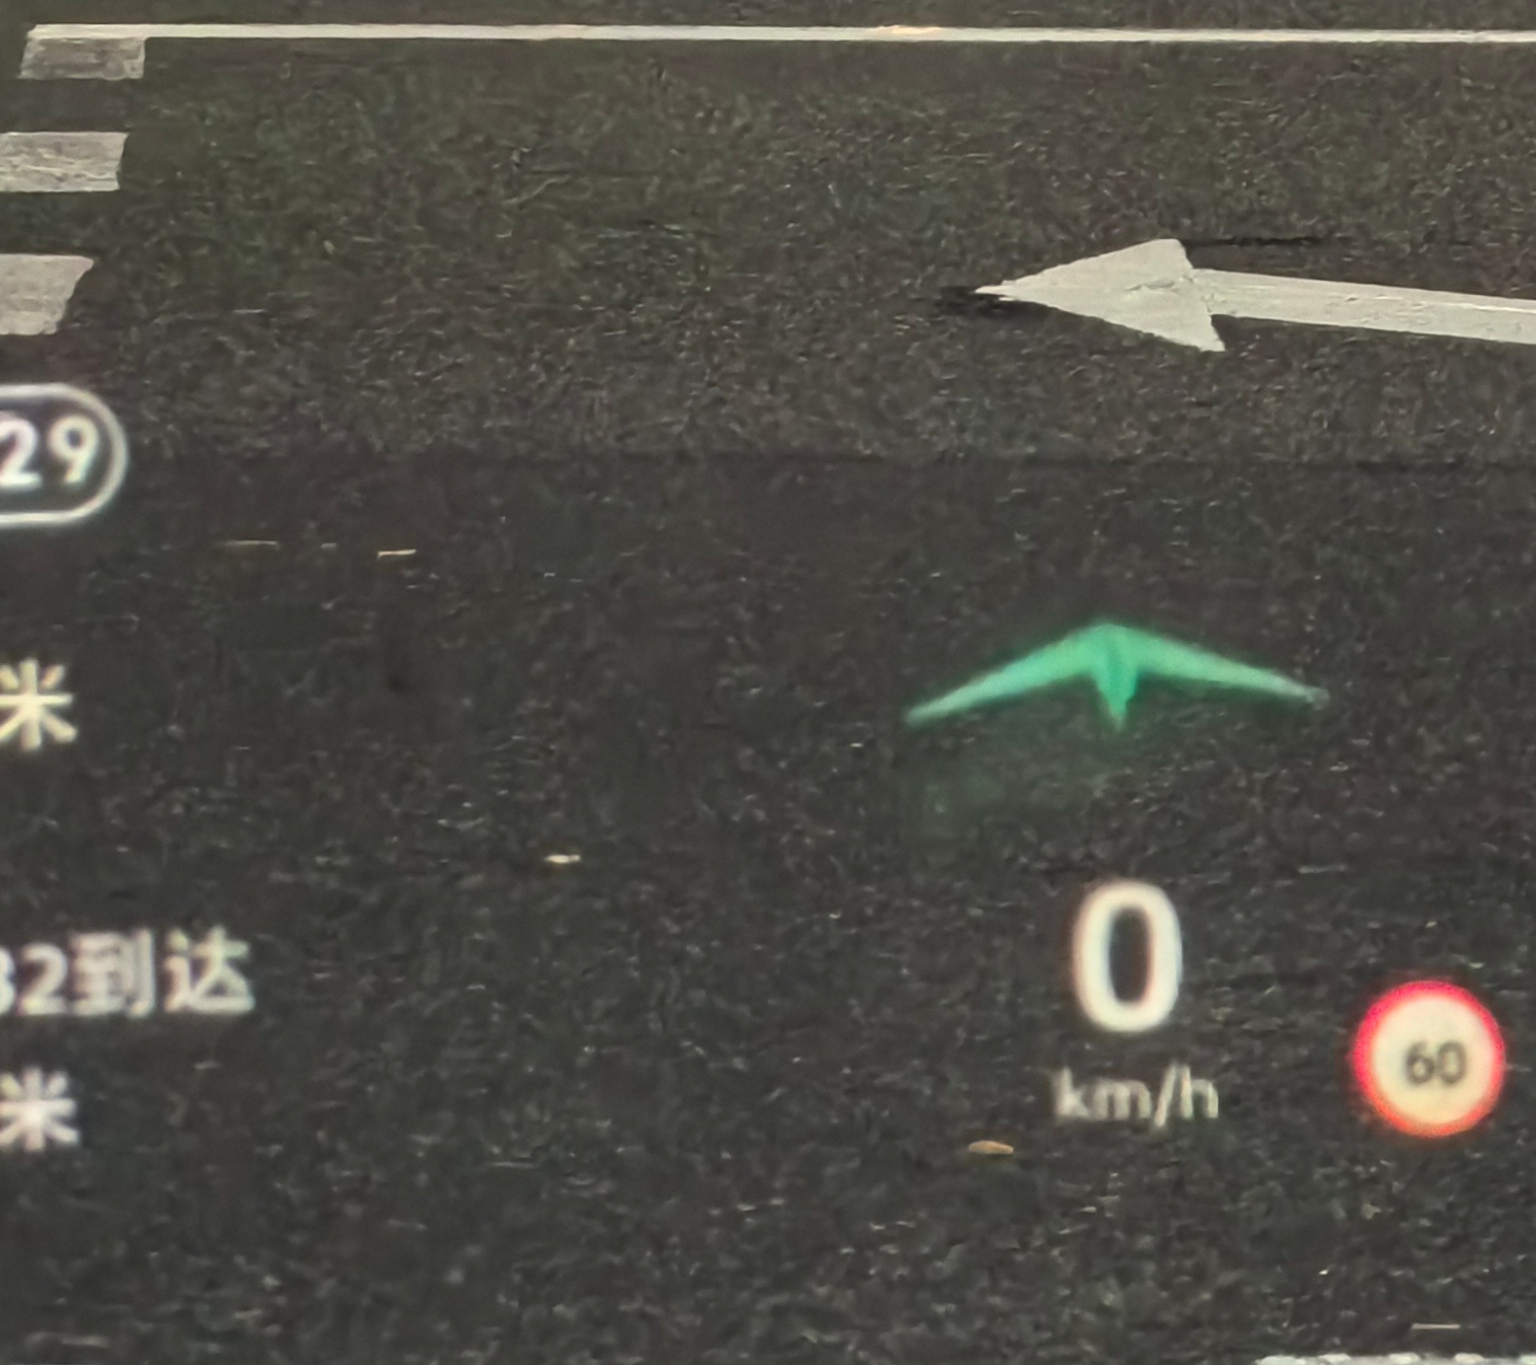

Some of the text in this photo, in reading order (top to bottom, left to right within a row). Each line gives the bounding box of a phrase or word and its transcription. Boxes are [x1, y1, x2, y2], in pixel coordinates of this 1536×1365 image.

[0, 658, 78, 751] 米
[1072, 879, 1183, 1033] 0
[1050, 1061, 1220, 1129] km/h
[1405, 1040, 1469, 1086] 60
[0, 1065, 81, 1152] 米
